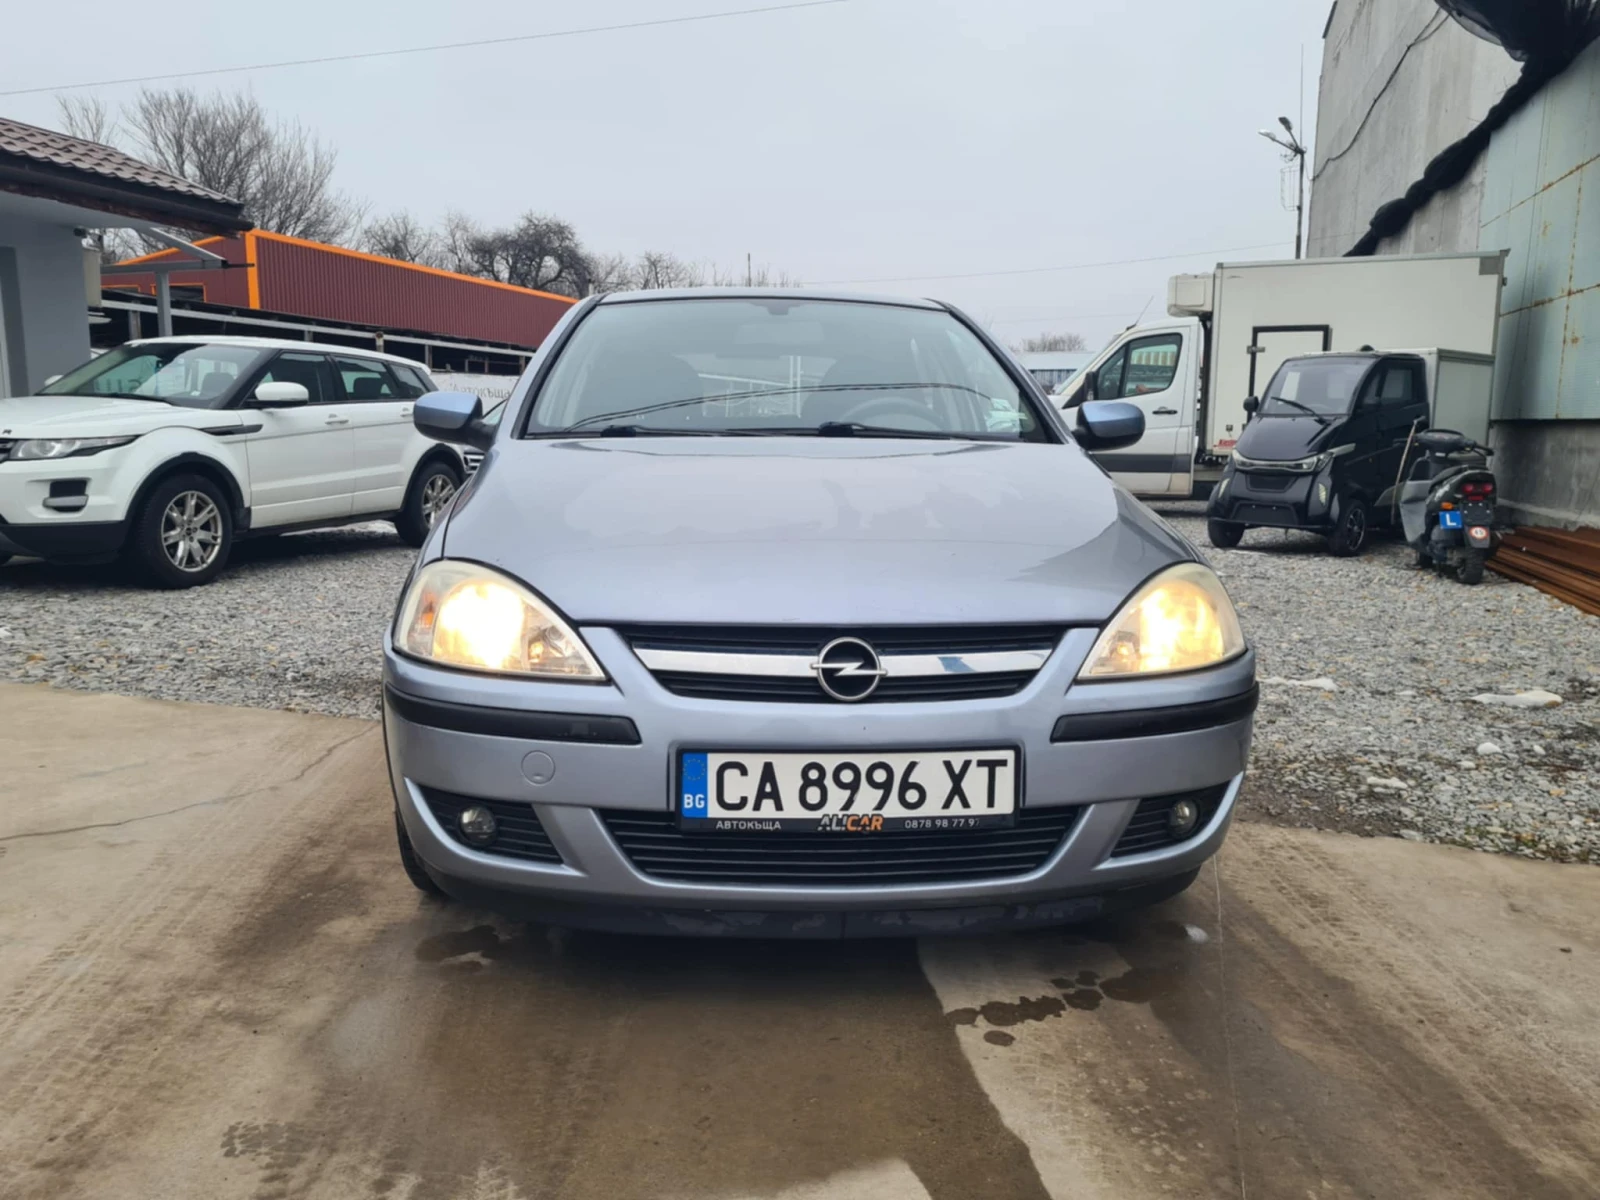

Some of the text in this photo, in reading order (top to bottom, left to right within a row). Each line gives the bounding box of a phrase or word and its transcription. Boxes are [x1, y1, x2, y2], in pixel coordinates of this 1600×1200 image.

[1446, 513, 1457, 526] L
[715, 759, 1008, 812] CA 8996 XT
[684, 794, 706, 809] BG
[716, 820, 782, 831] АВТОКЪЩА
[905, 819, 932, 829] 0878
[935, 819, 949, 828] 98
[952, 818, 965, 828] 77
